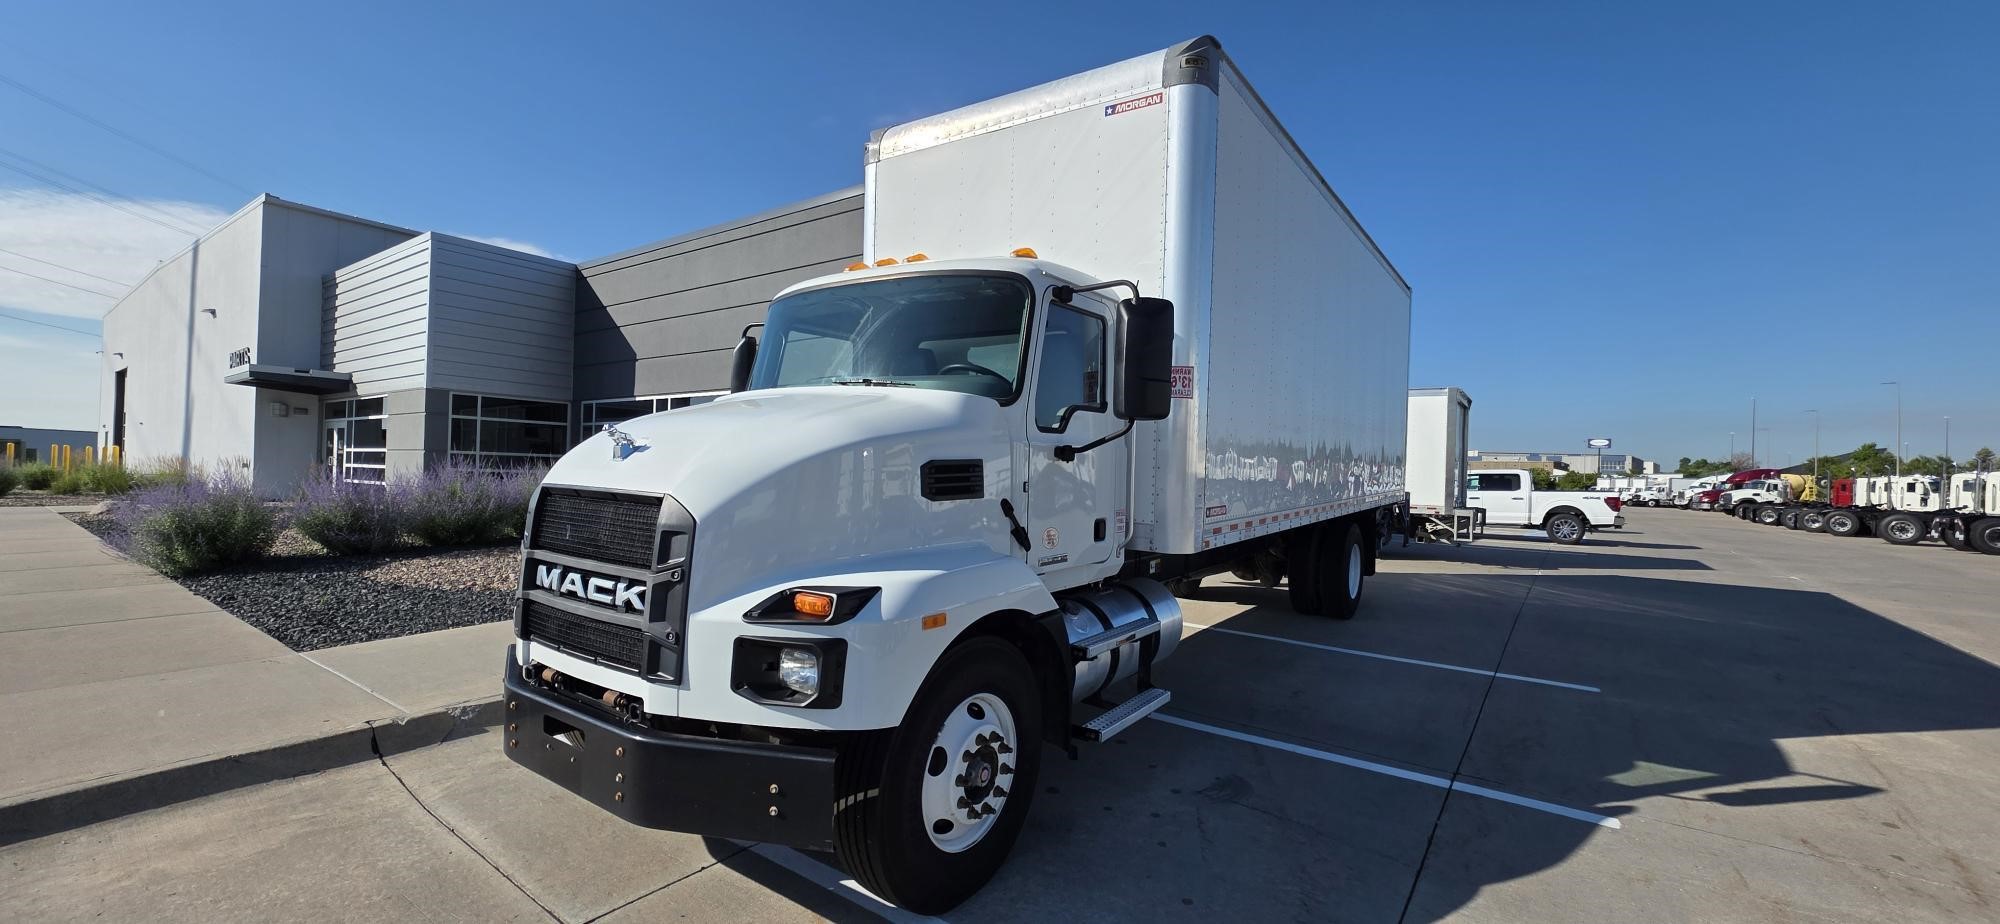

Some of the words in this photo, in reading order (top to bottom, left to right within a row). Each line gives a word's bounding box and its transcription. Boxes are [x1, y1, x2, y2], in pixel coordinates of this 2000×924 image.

[1114, 94, 1162, 114] MORGAN
[229, 346, 251, 369] PARTS
[535, 564, 647, 611] MACK
